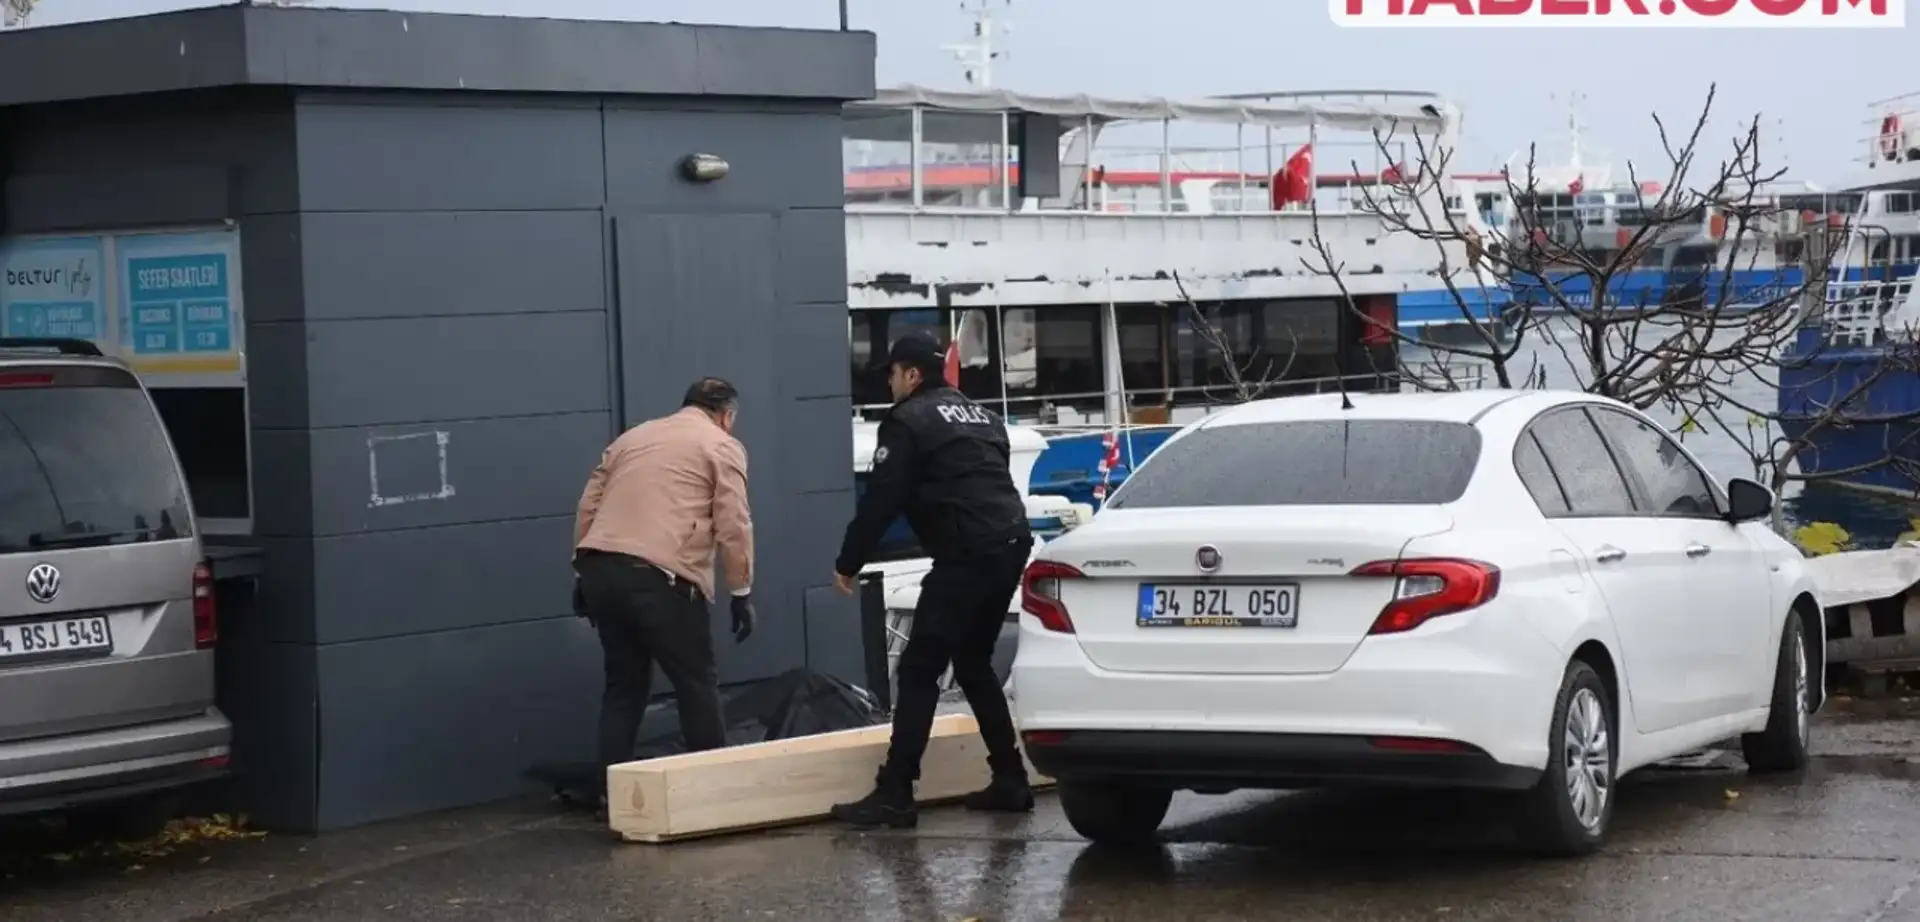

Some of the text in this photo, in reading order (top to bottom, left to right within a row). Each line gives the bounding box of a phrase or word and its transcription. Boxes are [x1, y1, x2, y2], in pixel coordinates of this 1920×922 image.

[1155, 590, 1290, 616] 34 BZL 050
[21, 623, 60, 651] BSJ
[66, 619, 104, 646] 549
